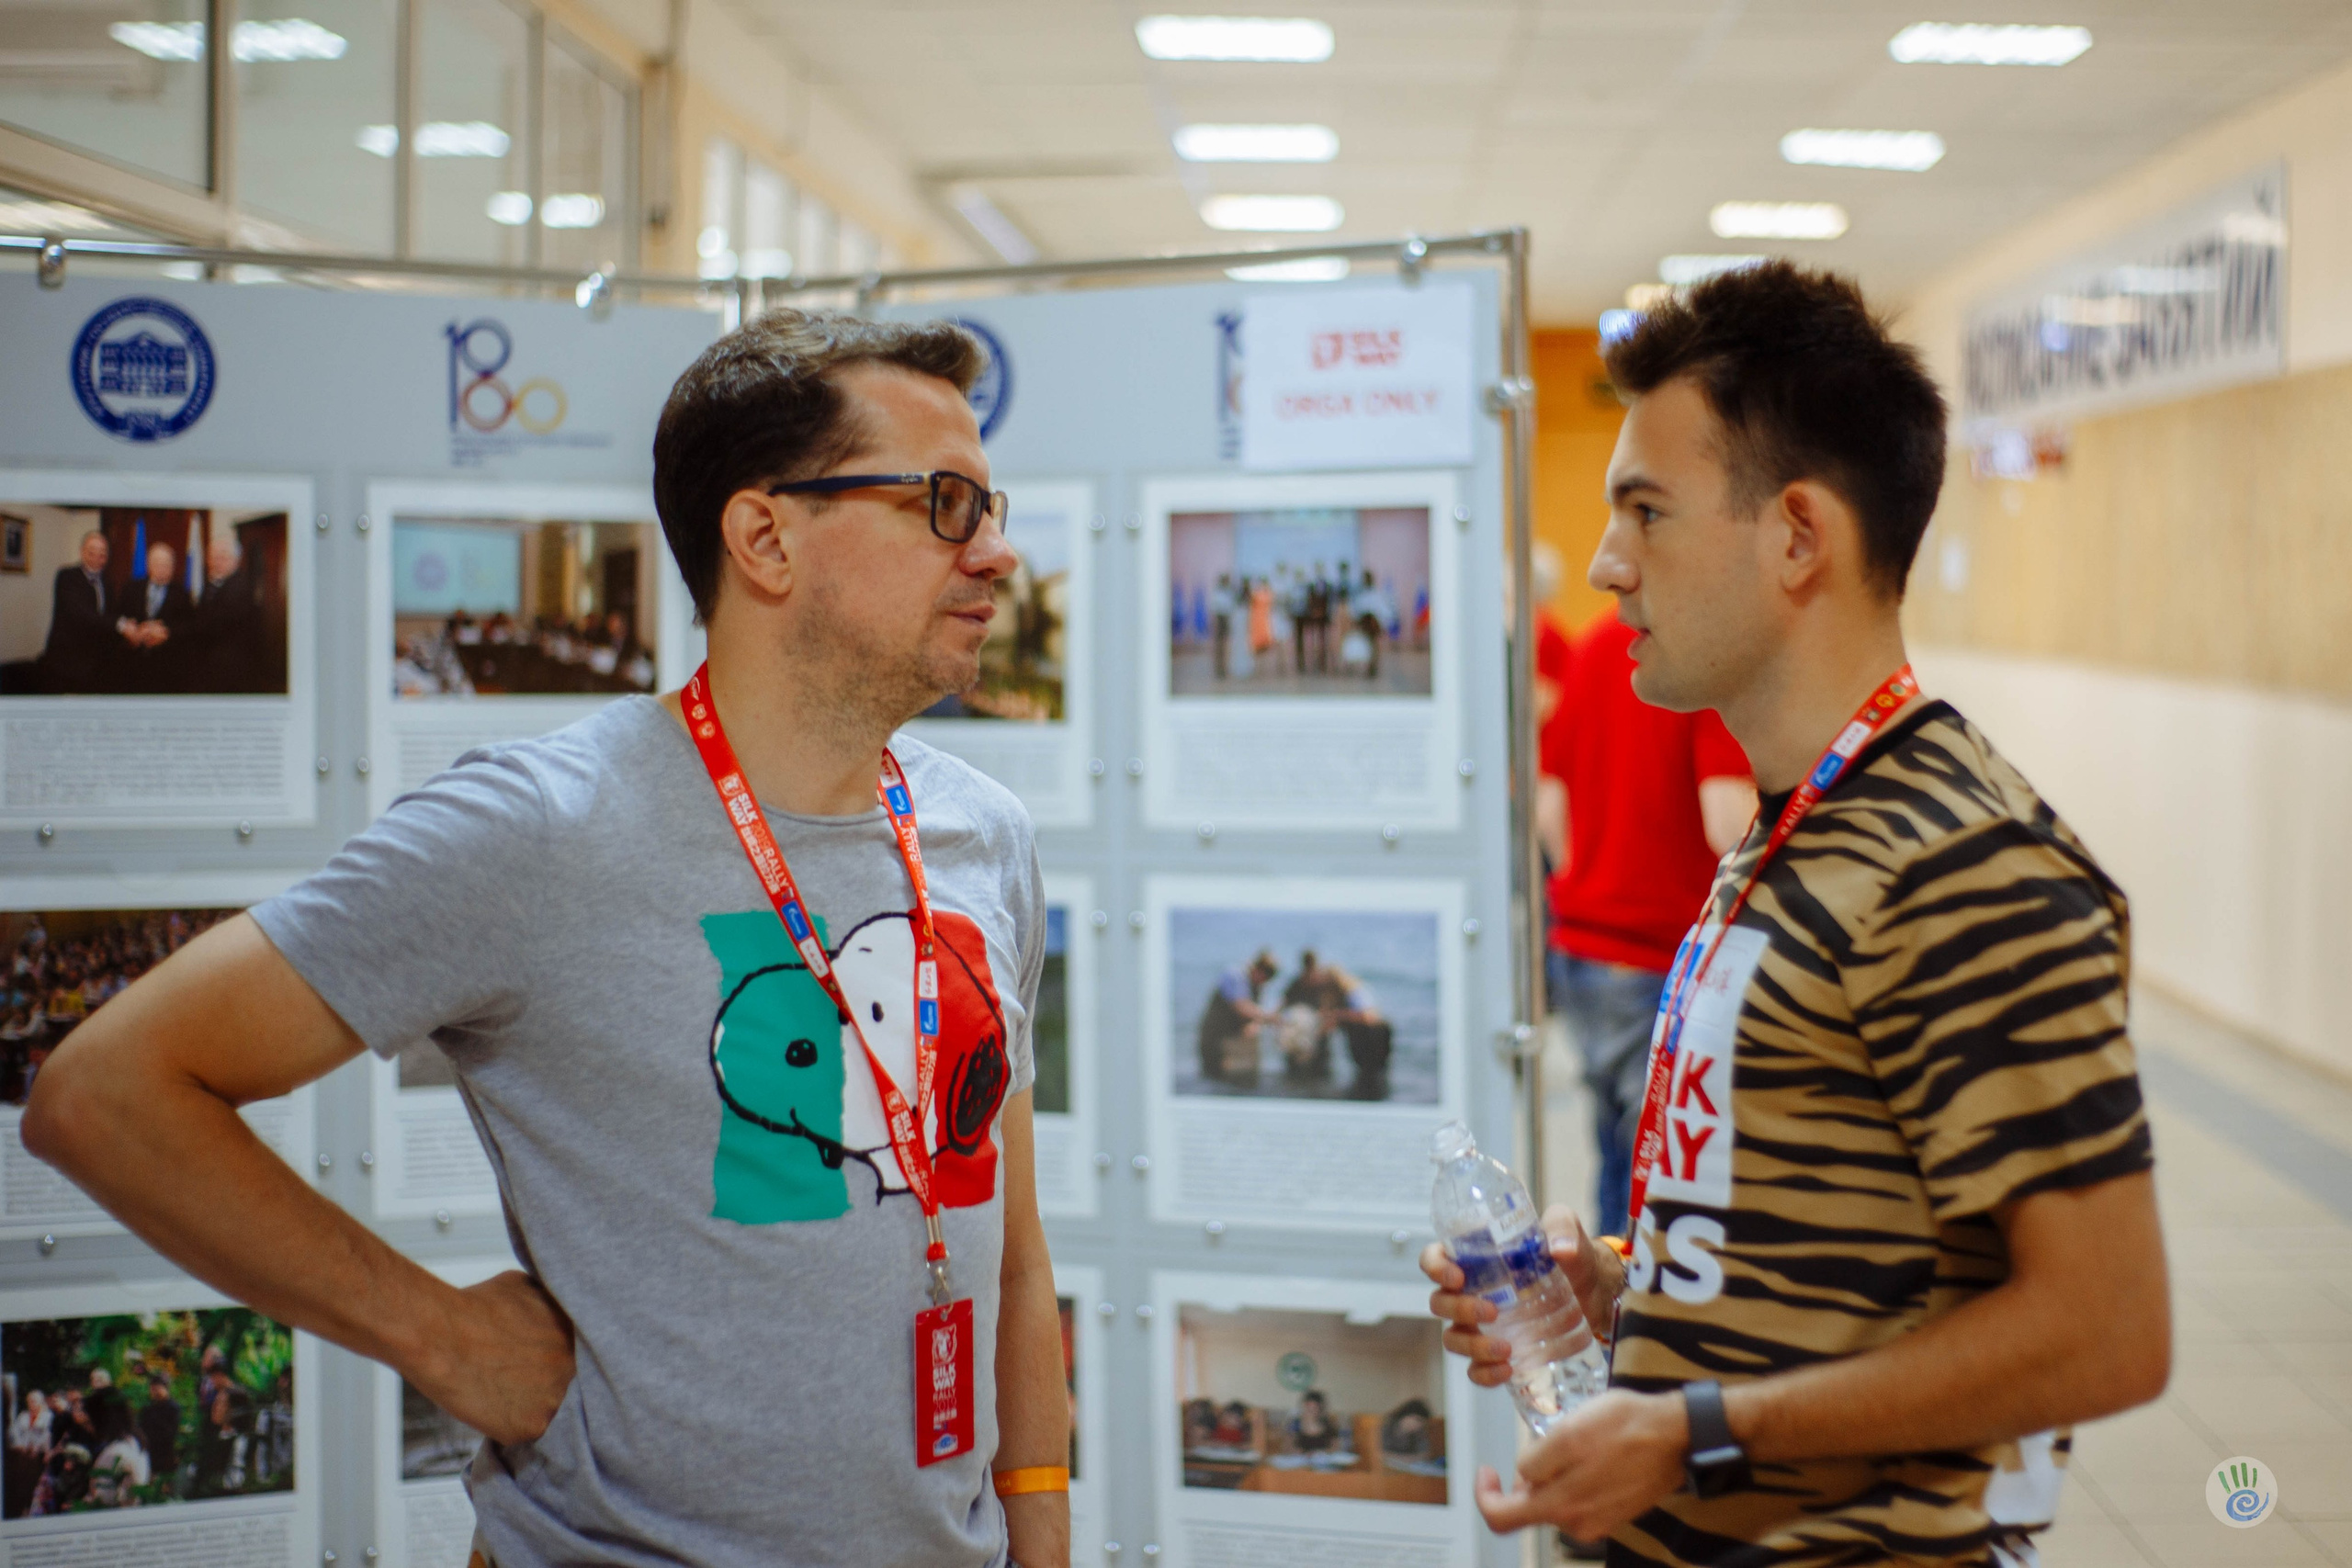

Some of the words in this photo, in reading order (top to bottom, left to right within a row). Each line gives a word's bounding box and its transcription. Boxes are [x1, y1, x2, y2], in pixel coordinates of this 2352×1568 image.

[1365, 390, 1437, 417] ONLY
[729, 797, 749, 826] WAY
[738, 793, 758, 823] SILK
[764, 846, 789, 888] RALLY
[891, 1113, 907, 1145] WAY
[900, 1110, 917, 1142] SILK
[933, 1362, 956, 1379] SILK
[933, 1376, 956, 1392] WAY
[933, 1388, 956, 1402] RALLY
